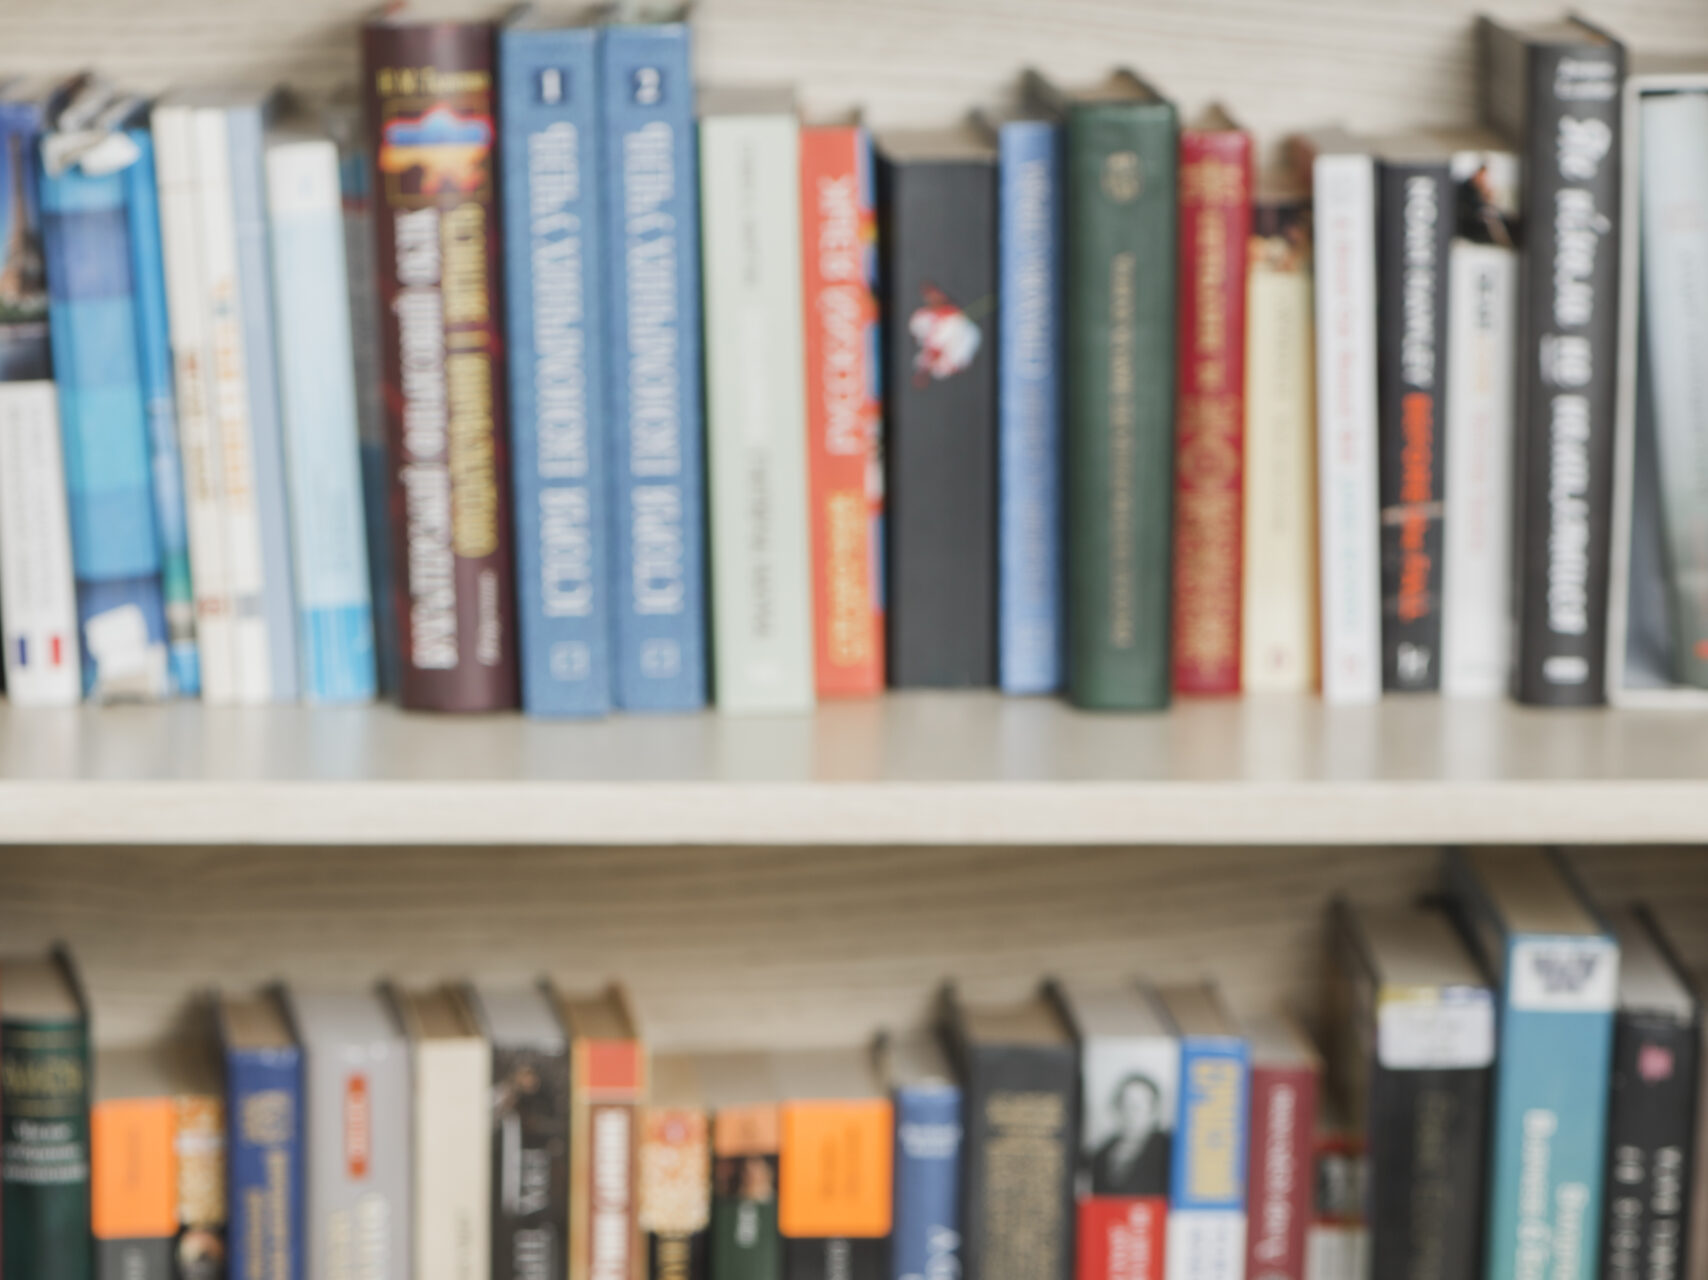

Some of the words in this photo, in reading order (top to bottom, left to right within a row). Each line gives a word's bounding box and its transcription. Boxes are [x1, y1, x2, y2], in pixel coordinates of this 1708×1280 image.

[636, 67, 661, 104] 2
[528, 122, 581, 237] УЧЕНЬ
[623, 122, 676, 237] УЧЕНЬ
[818, 175, 857, 281] ЯЗЫК
[531, 237, 588, 477] ЕКОНОМІЧНИХ
[626, 237, 680, 476] ЕКОНОМІЧНИХ
[816, 286, 862, 455] РУССКИЙ
[540, 487, 592, 618] ІСТОРІЯ
[632, 486, 684, 616] ІСТОРІЯ
